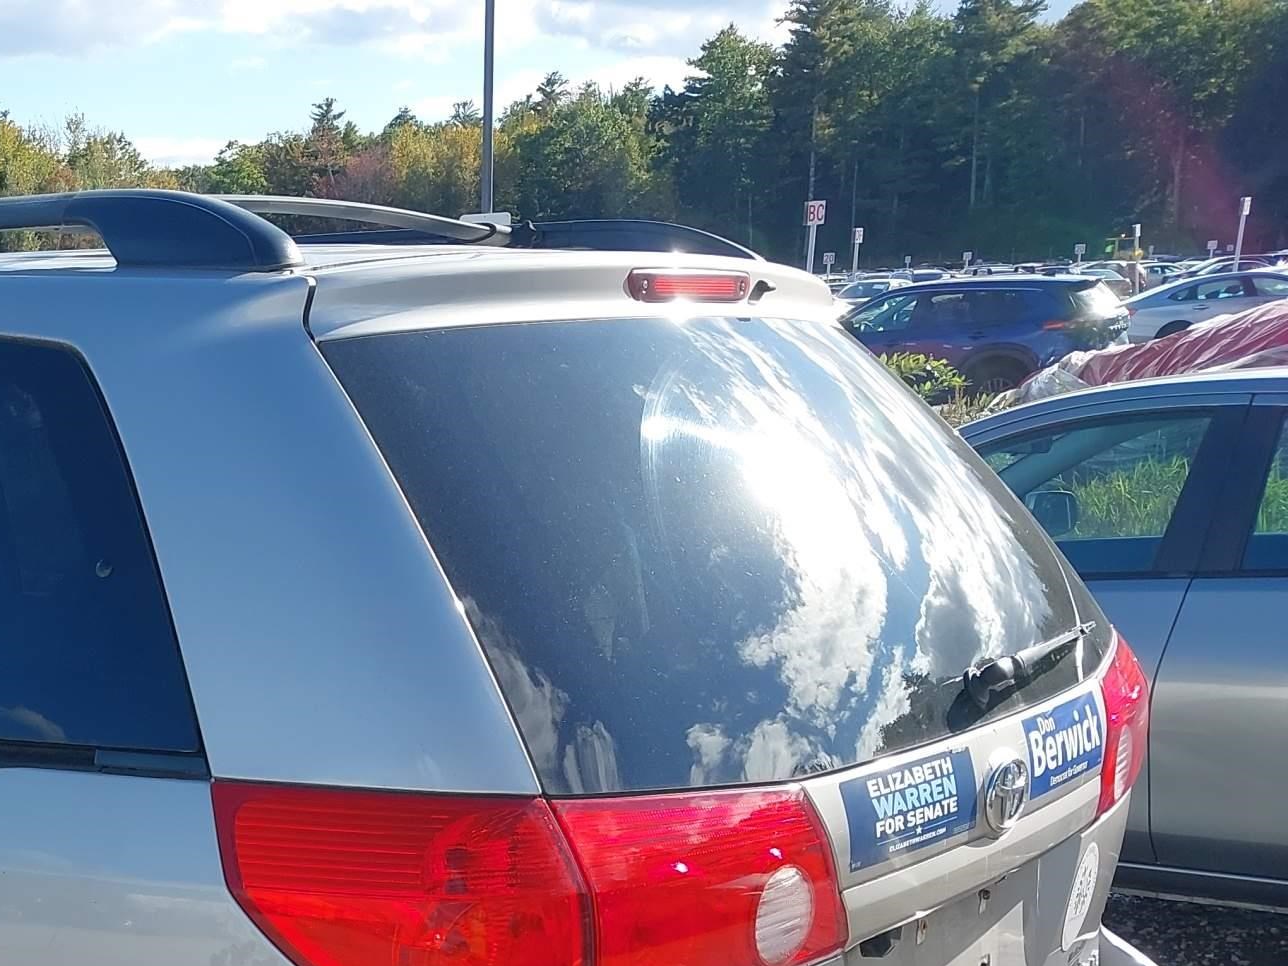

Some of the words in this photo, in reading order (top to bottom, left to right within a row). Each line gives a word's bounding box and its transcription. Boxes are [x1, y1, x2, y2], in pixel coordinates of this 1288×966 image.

[808, 203, 825, 222] BC
[1028, 703, 1101, 777] Berwick
[1036, 716, 1056, 736] Don
[866, 756, 954, 798] ELIZABETH
[872, 774, 958, 820] WARREN
[875, 813, 905, 838] FOR
[906, 796, 959, 828] SENATE
